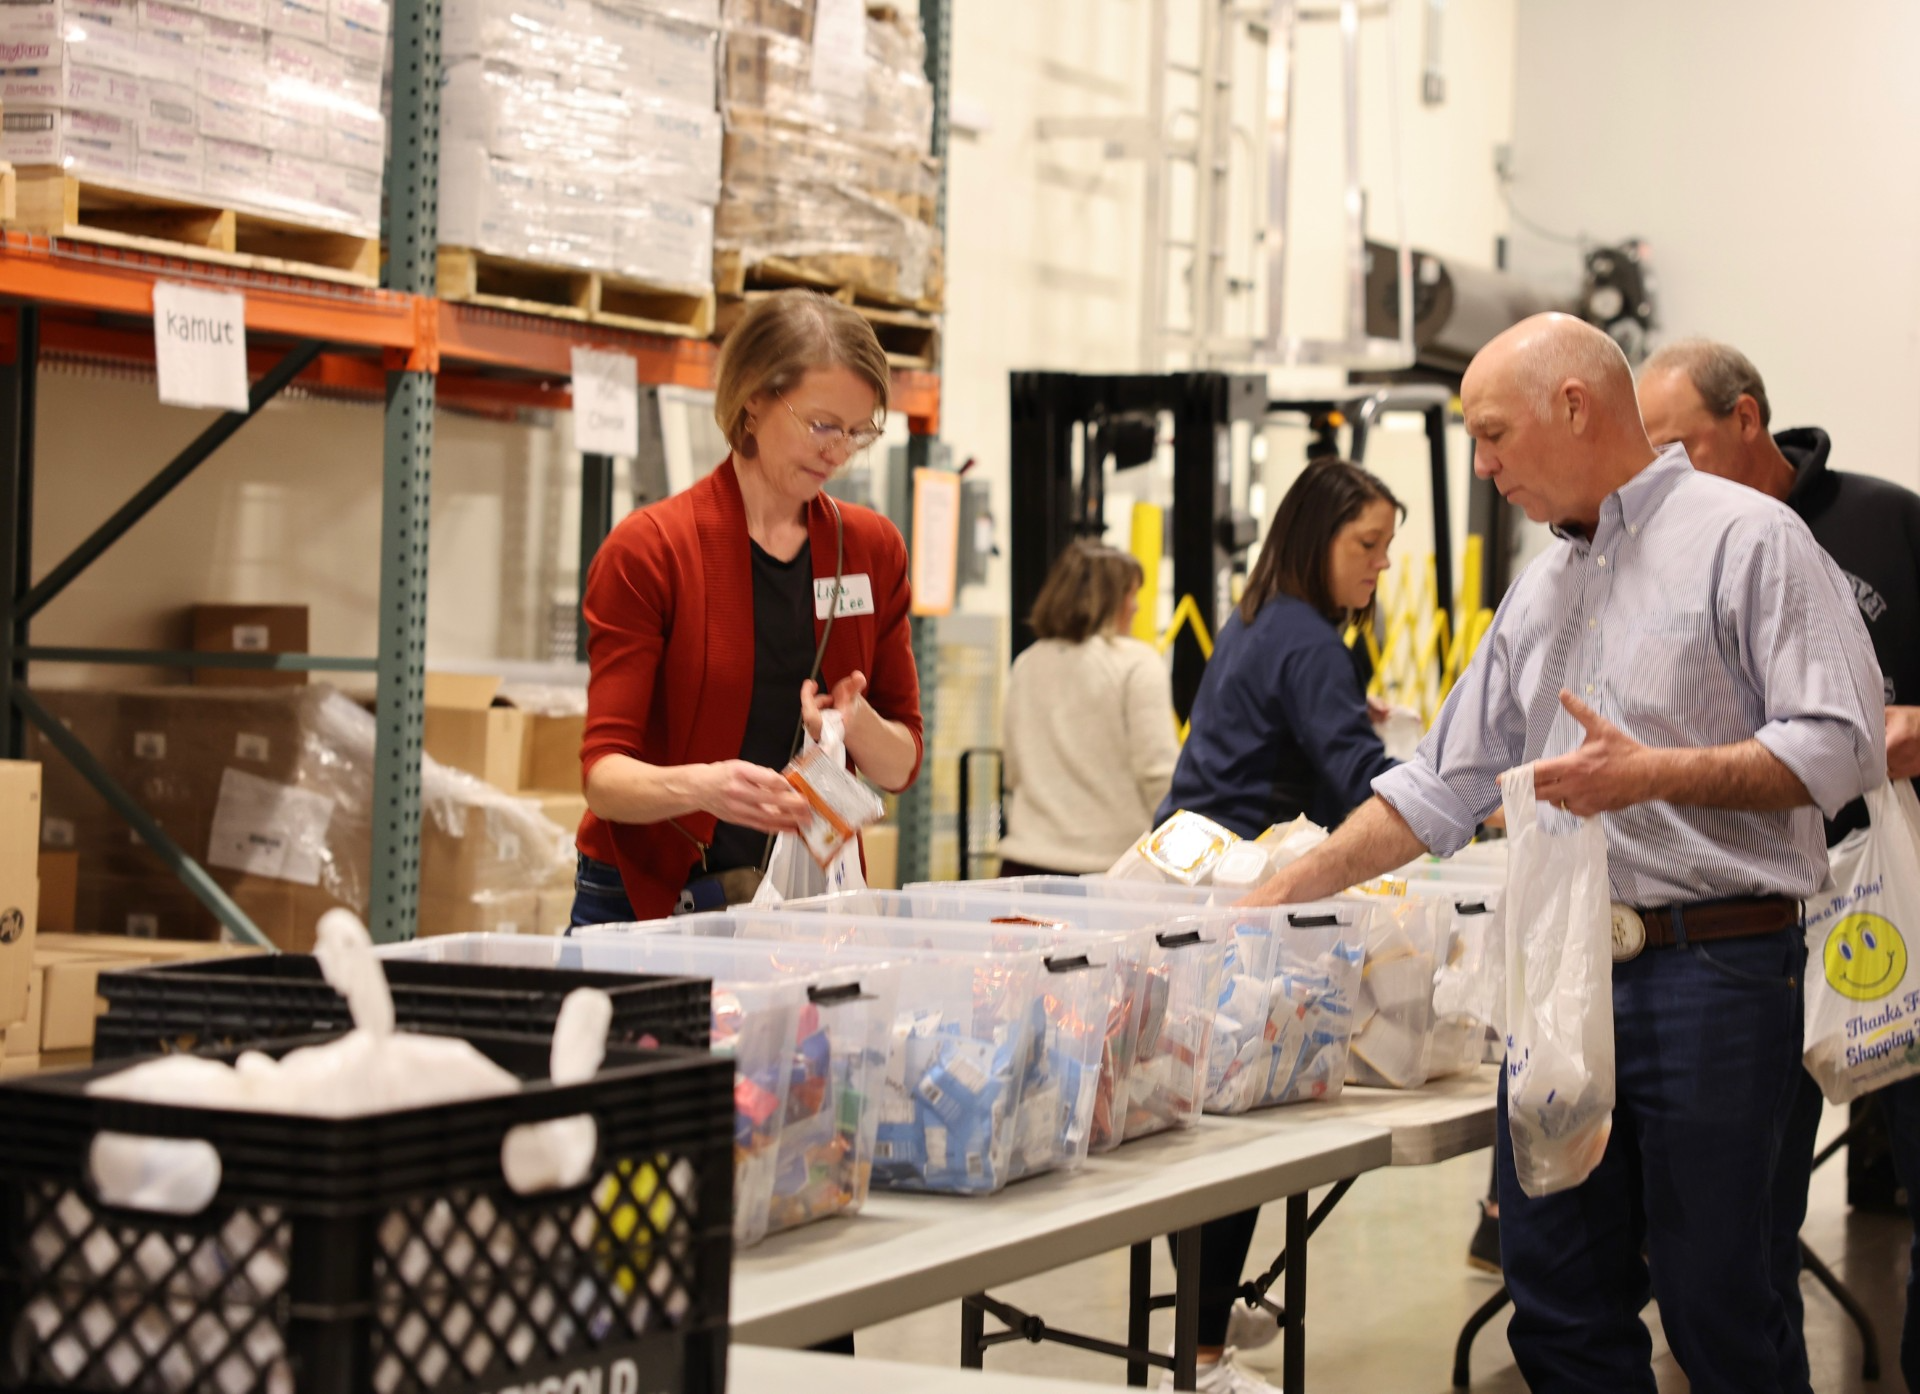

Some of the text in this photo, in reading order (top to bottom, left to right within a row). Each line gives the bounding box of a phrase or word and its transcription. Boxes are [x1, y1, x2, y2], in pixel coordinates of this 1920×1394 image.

[166, 309, 235, 346] kamut
[1853, 874, 1883, 901] Day!
[1845, 1001, 1904, 1038] Thanks
[1845, 1027, 1915, 1067] Shopping
